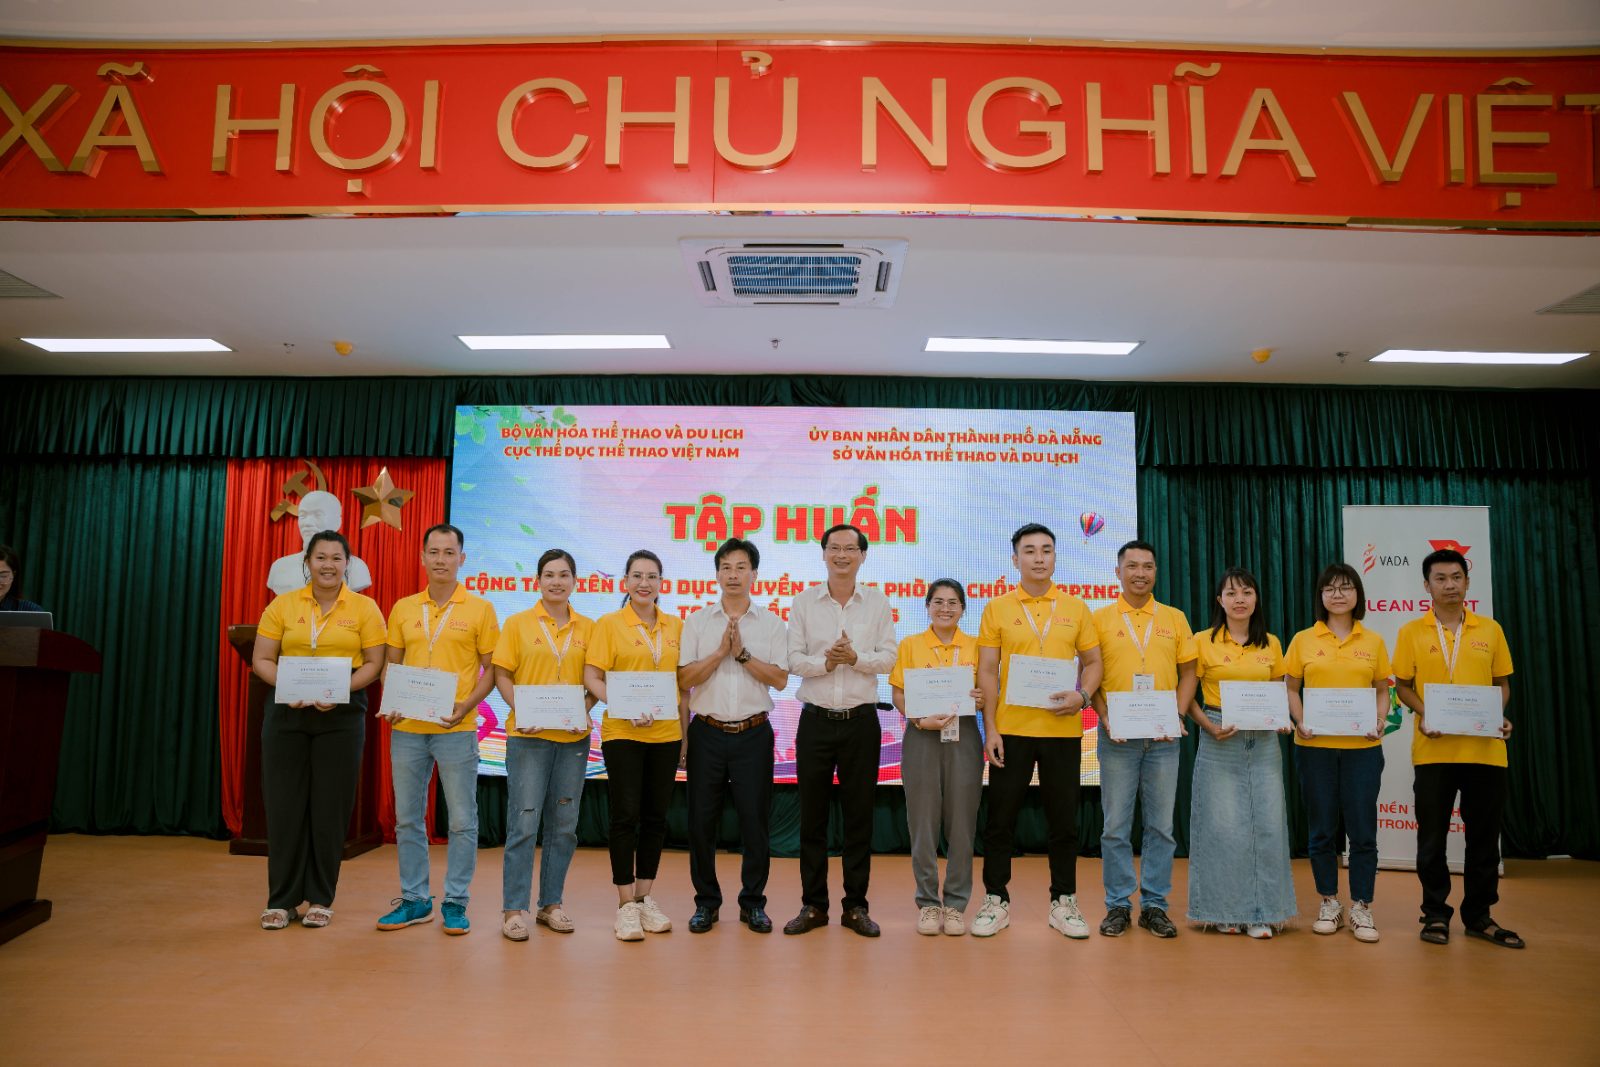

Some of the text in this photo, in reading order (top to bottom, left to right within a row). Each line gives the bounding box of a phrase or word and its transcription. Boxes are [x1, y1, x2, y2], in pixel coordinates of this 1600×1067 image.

[0, 62, 164, 177] XÃ
[211, 64, 440, 194] HỘI
[497, 51, 799, 171] CHỦ
[861, 62, 1317, 182] NGHĨA
[501, 420, 744, 443] BỘ VĂN HÓA THỂ THAO VÀ DU LỊCH
[809, 425, 1102, 445] ỦY BAN NHÂN DÂN THÀNH PHỐ ĐÀ NẴNG
[504, 439, 739, 461] CỤC THỂ DỤC THỂ THAO VIỆT NAM
[832, 443, 1079, 467] SỞ VĂN HÓA THỂ THAO VÀ DU LỊCH
[665, 486, 918, 551] TẬP HUẤN
[1380, 556, 1409, 567] VADA
[465, 572, 517, 595] CỘNG
[576, 574, 614, 593] IÊN
[677, 579, 718, 599] DỤC
[750, 572, 804, 596] UYỀN
[884, 578, 929, 598] PHÒ
[967, 575, 1019, 599] CHỐ
[1056, 584, 1121, 600] PING
[1367, 600, 1414, 612] LEAN
